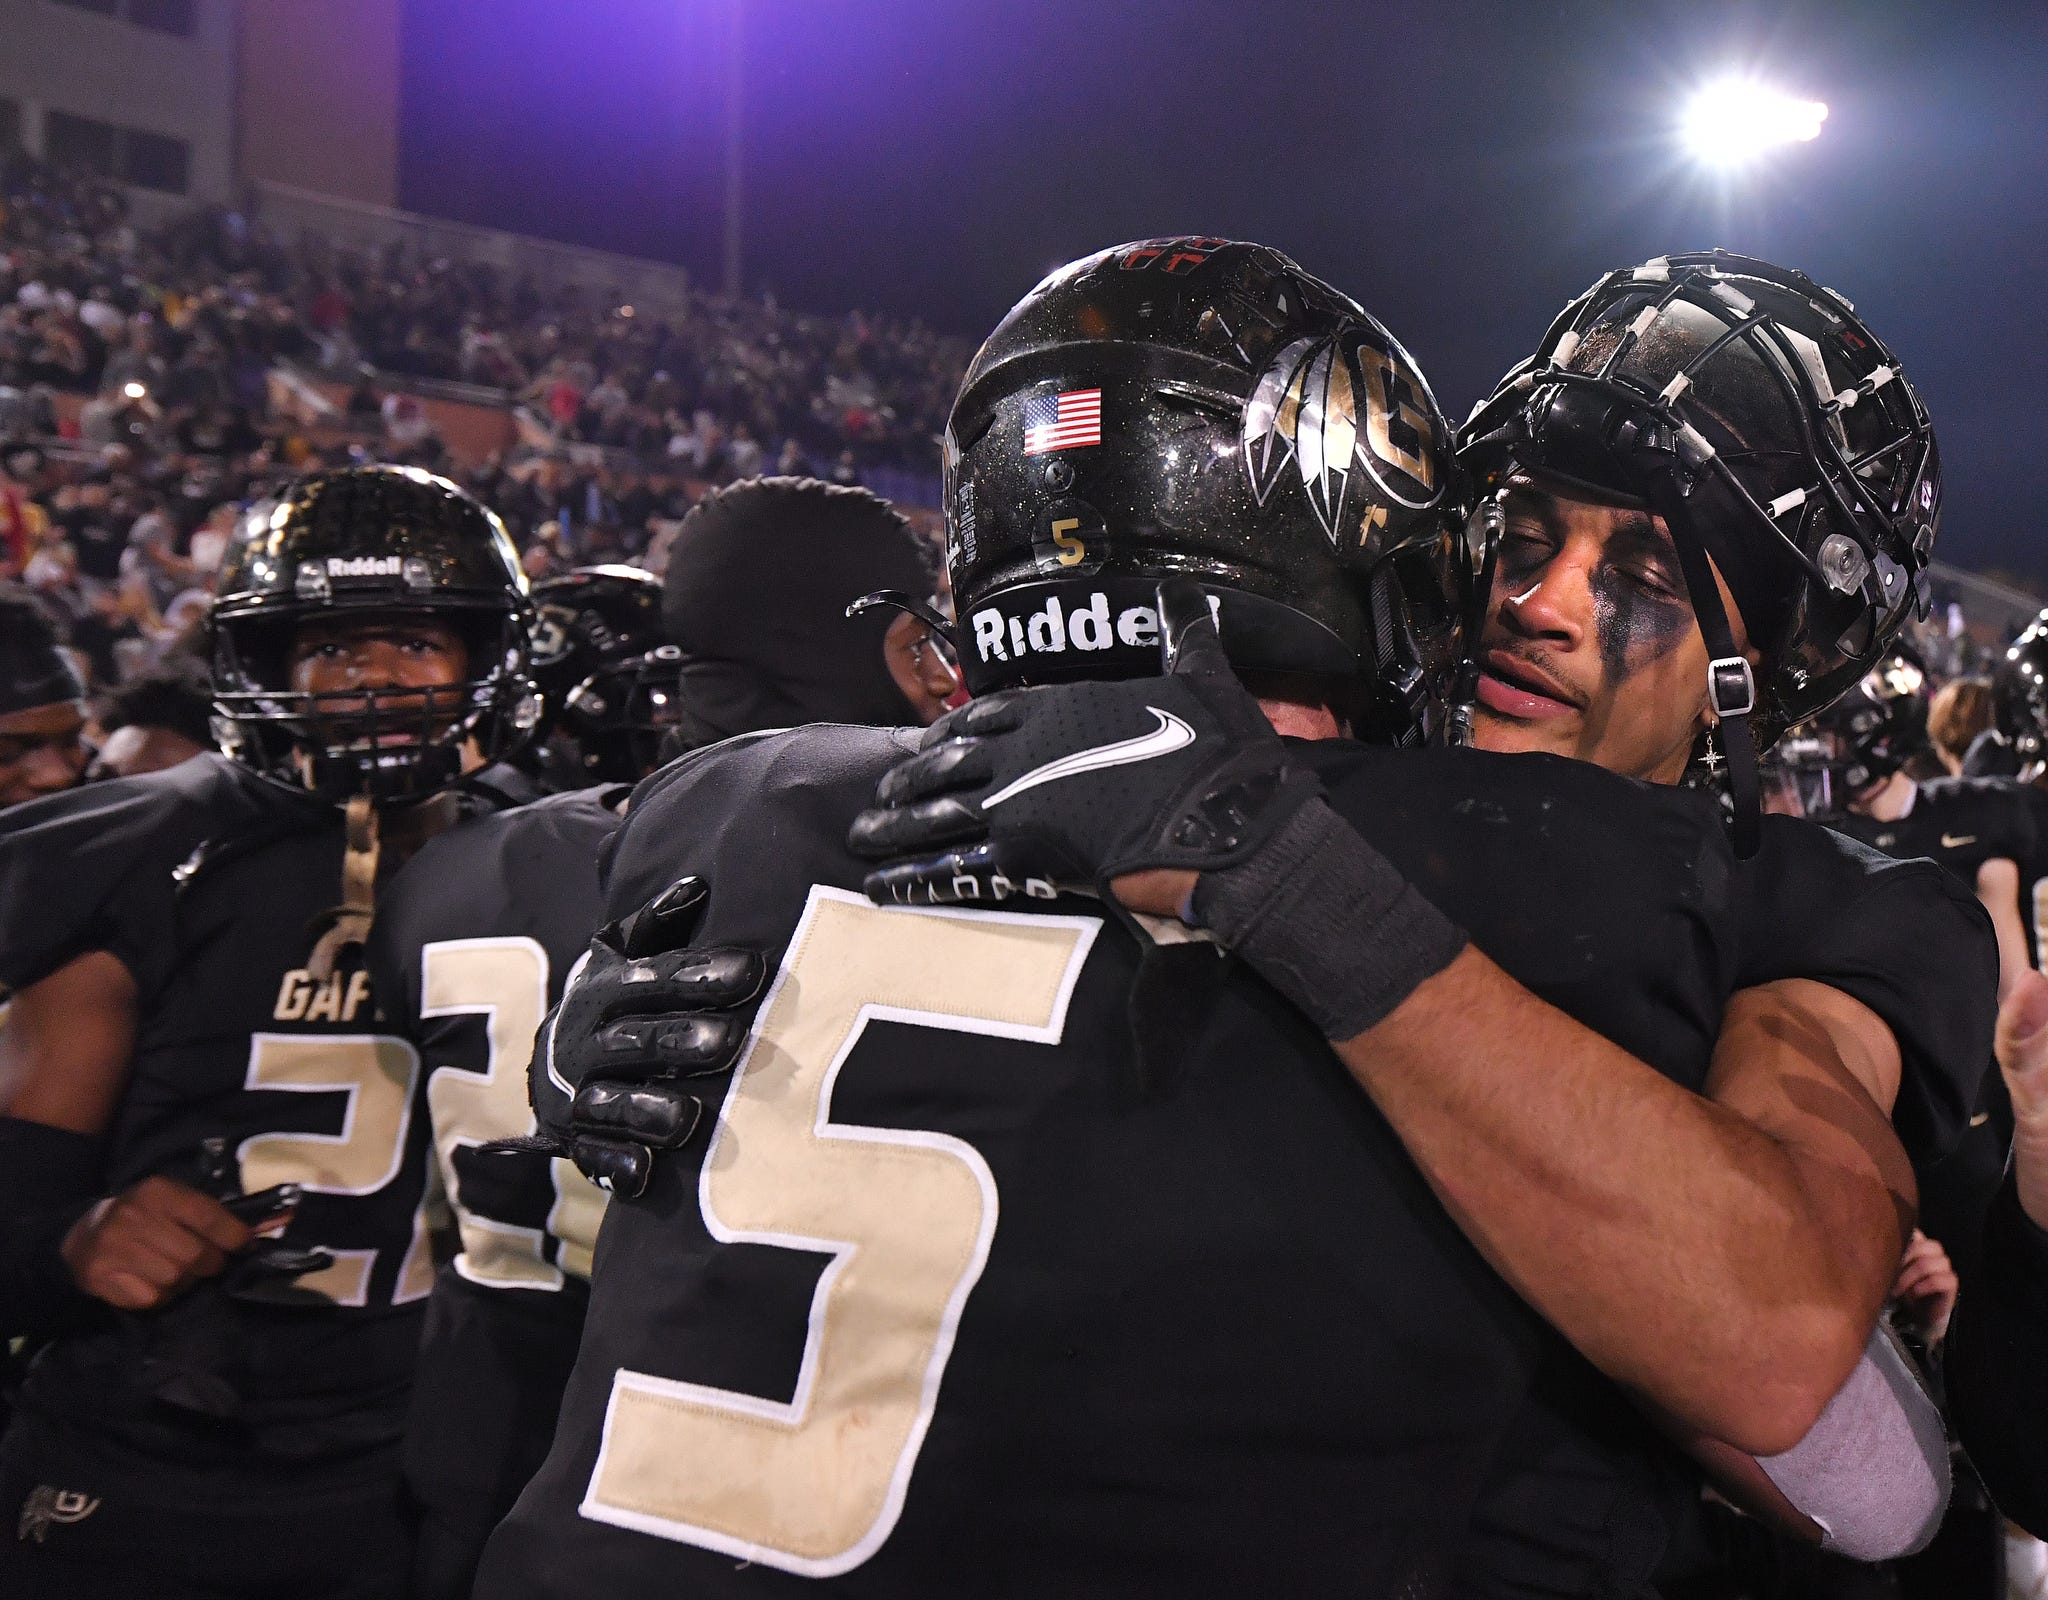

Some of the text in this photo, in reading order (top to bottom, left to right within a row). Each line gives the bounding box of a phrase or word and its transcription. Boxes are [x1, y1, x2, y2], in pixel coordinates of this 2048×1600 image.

[327, 556, 401, 577] Riddell
[1052, 518, 1084, 566] 5
[972, 592, 1220, 663] Ridde
[578, 884, 1104, 1578] 5
